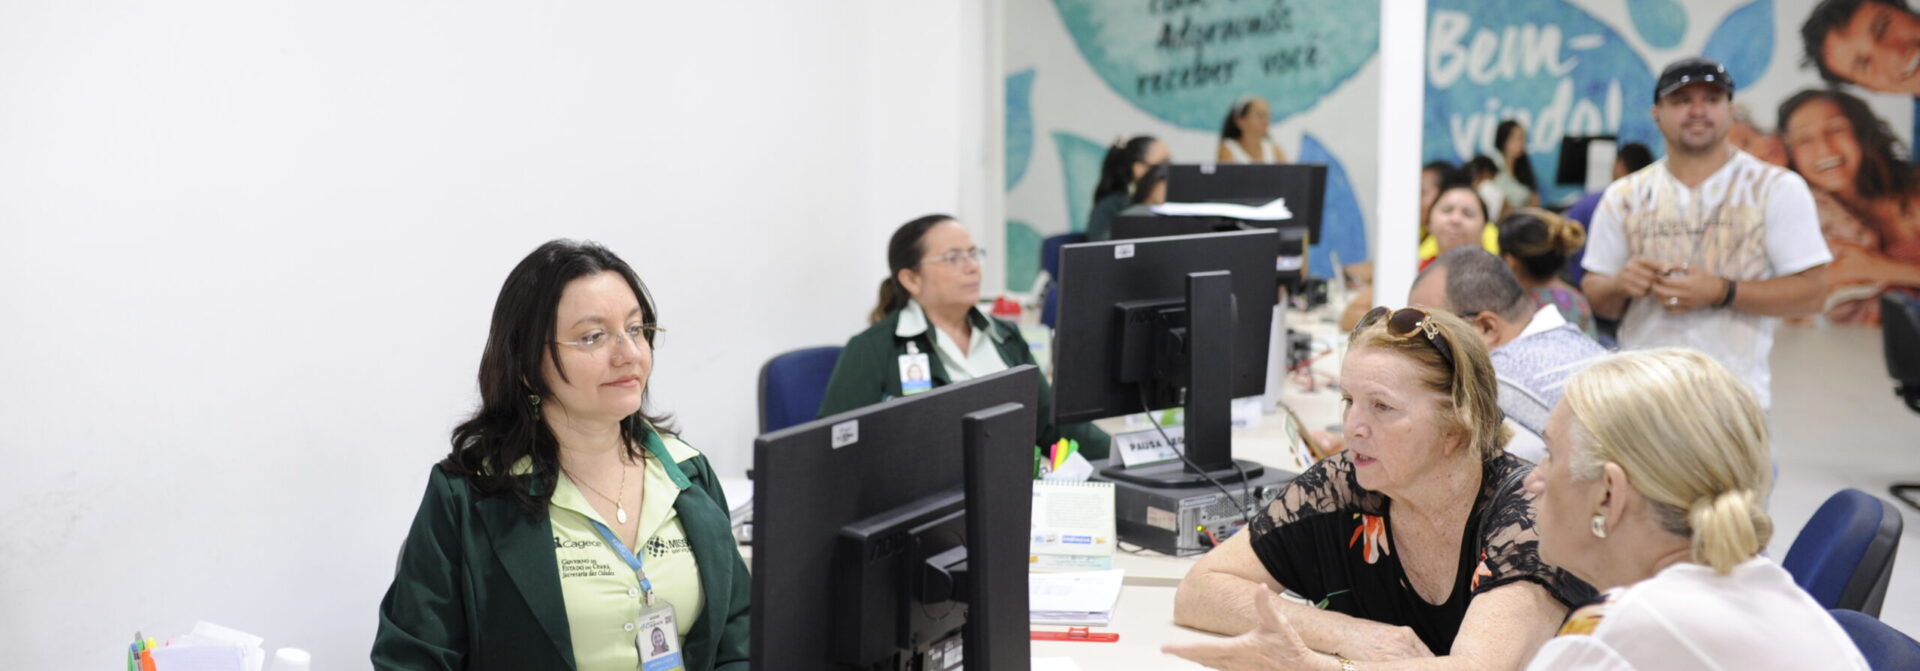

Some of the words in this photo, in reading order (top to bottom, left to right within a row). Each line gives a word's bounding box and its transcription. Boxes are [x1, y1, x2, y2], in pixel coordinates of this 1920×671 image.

[1428, 10, 1606, 90] Bem-
[1128, 440, 1163, 452] PAUSA
[562, 540, 602, 550] Cagece
